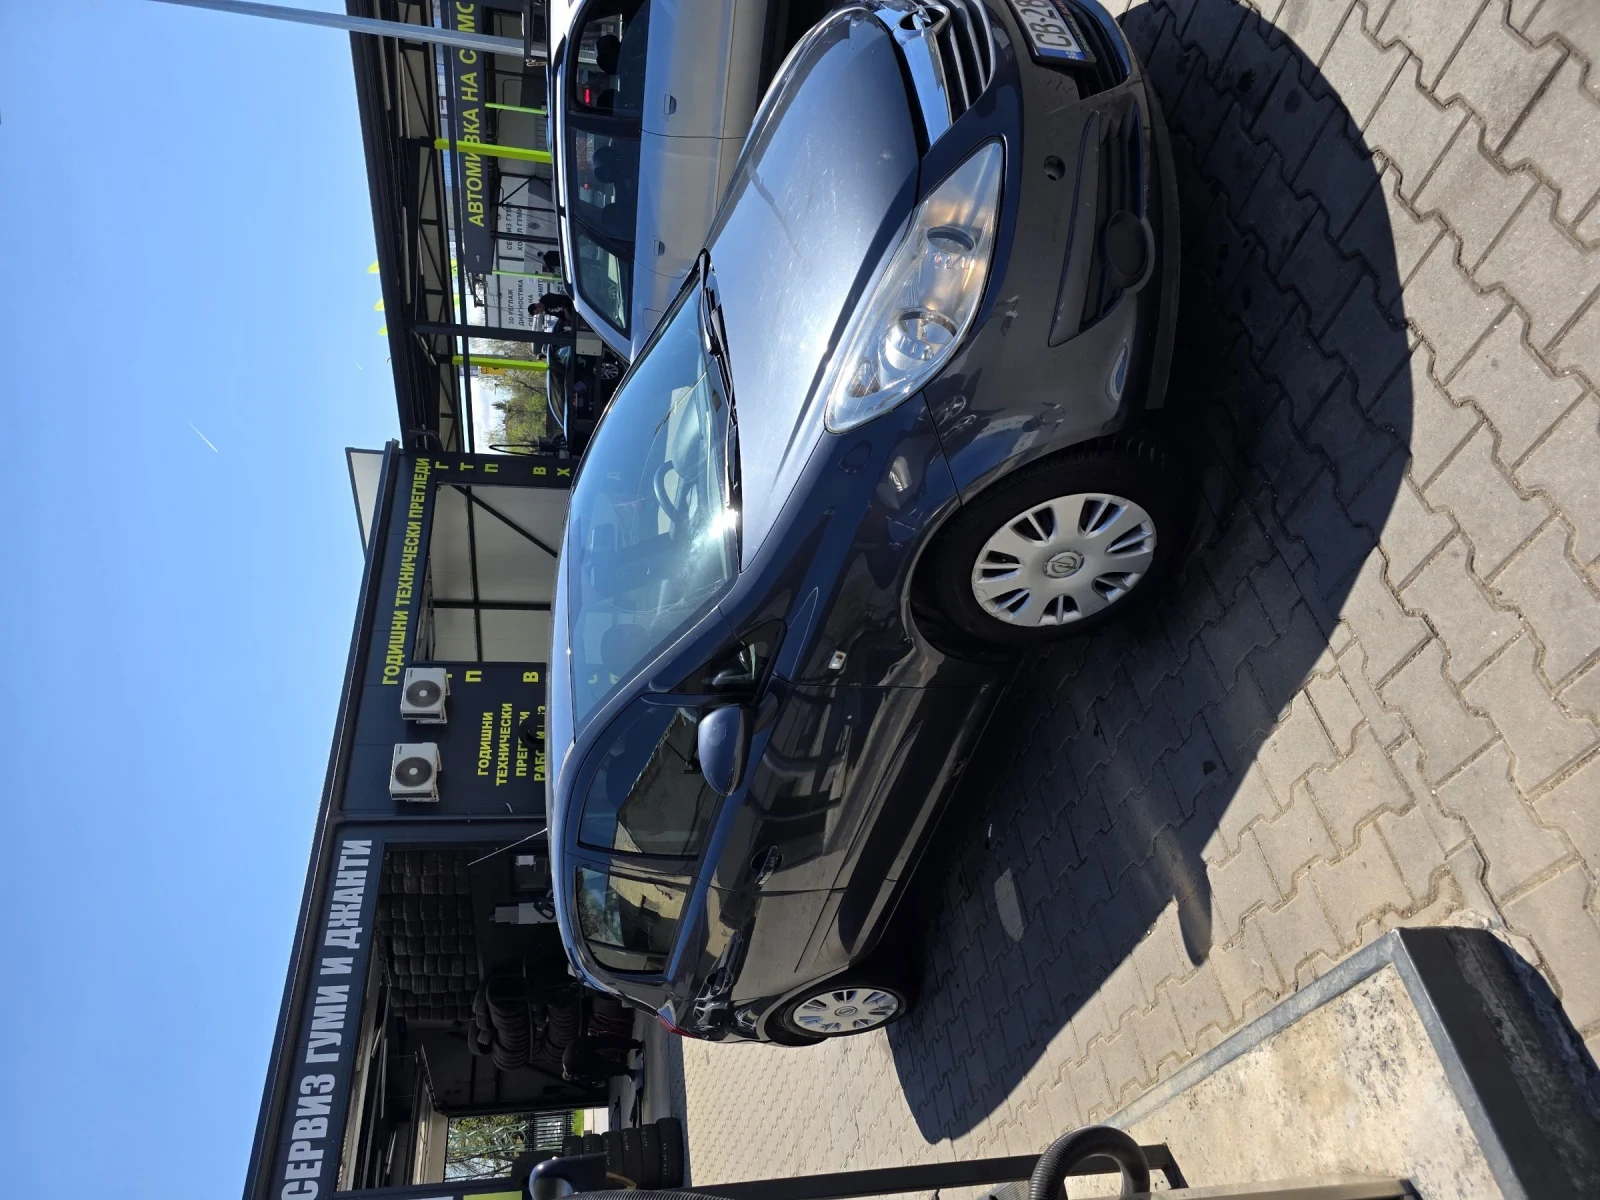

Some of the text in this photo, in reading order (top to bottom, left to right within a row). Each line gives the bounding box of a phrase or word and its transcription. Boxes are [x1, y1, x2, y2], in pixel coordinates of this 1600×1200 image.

[456, 1, 477, 64] СМО
[459, 72, 478, 102] НА
[516, 228, 524, 251] ХОЛ
[382, 458, 431, 684] ГОДИШНИ ТЕХНИЧЕСКИ ПРЕГЛЕДИ
[478, 712, 494, 776] ГОДИШНИ
[496, 703, 512, 786] ТЕХНИЧЕСКИ
[516, 711, 530, 776] ПРЕГИ
[281, 840, 372, 1200] СЕРВИЗ ГУМИ И ДЖАНТИ
